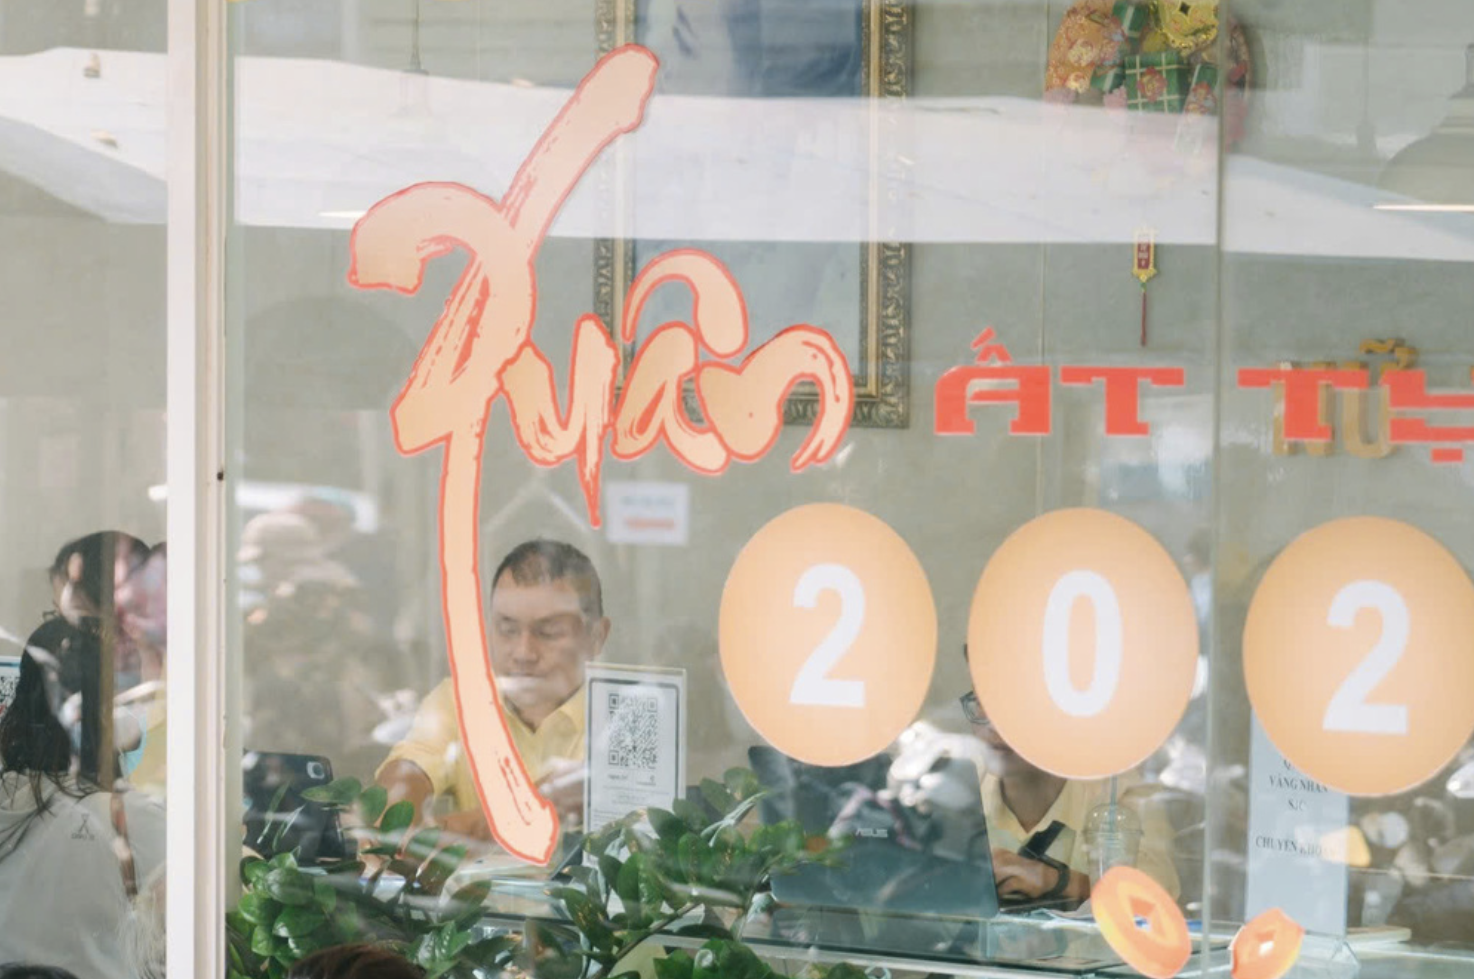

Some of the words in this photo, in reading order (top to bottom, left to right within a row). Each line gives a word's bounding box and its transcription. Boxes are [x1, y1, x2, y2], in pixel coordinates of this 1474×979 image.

[934, 326, 1186, 438] ẤT
[348, 43, 854, 865] Xuân
[855, 827, 888, 838] ASUS
